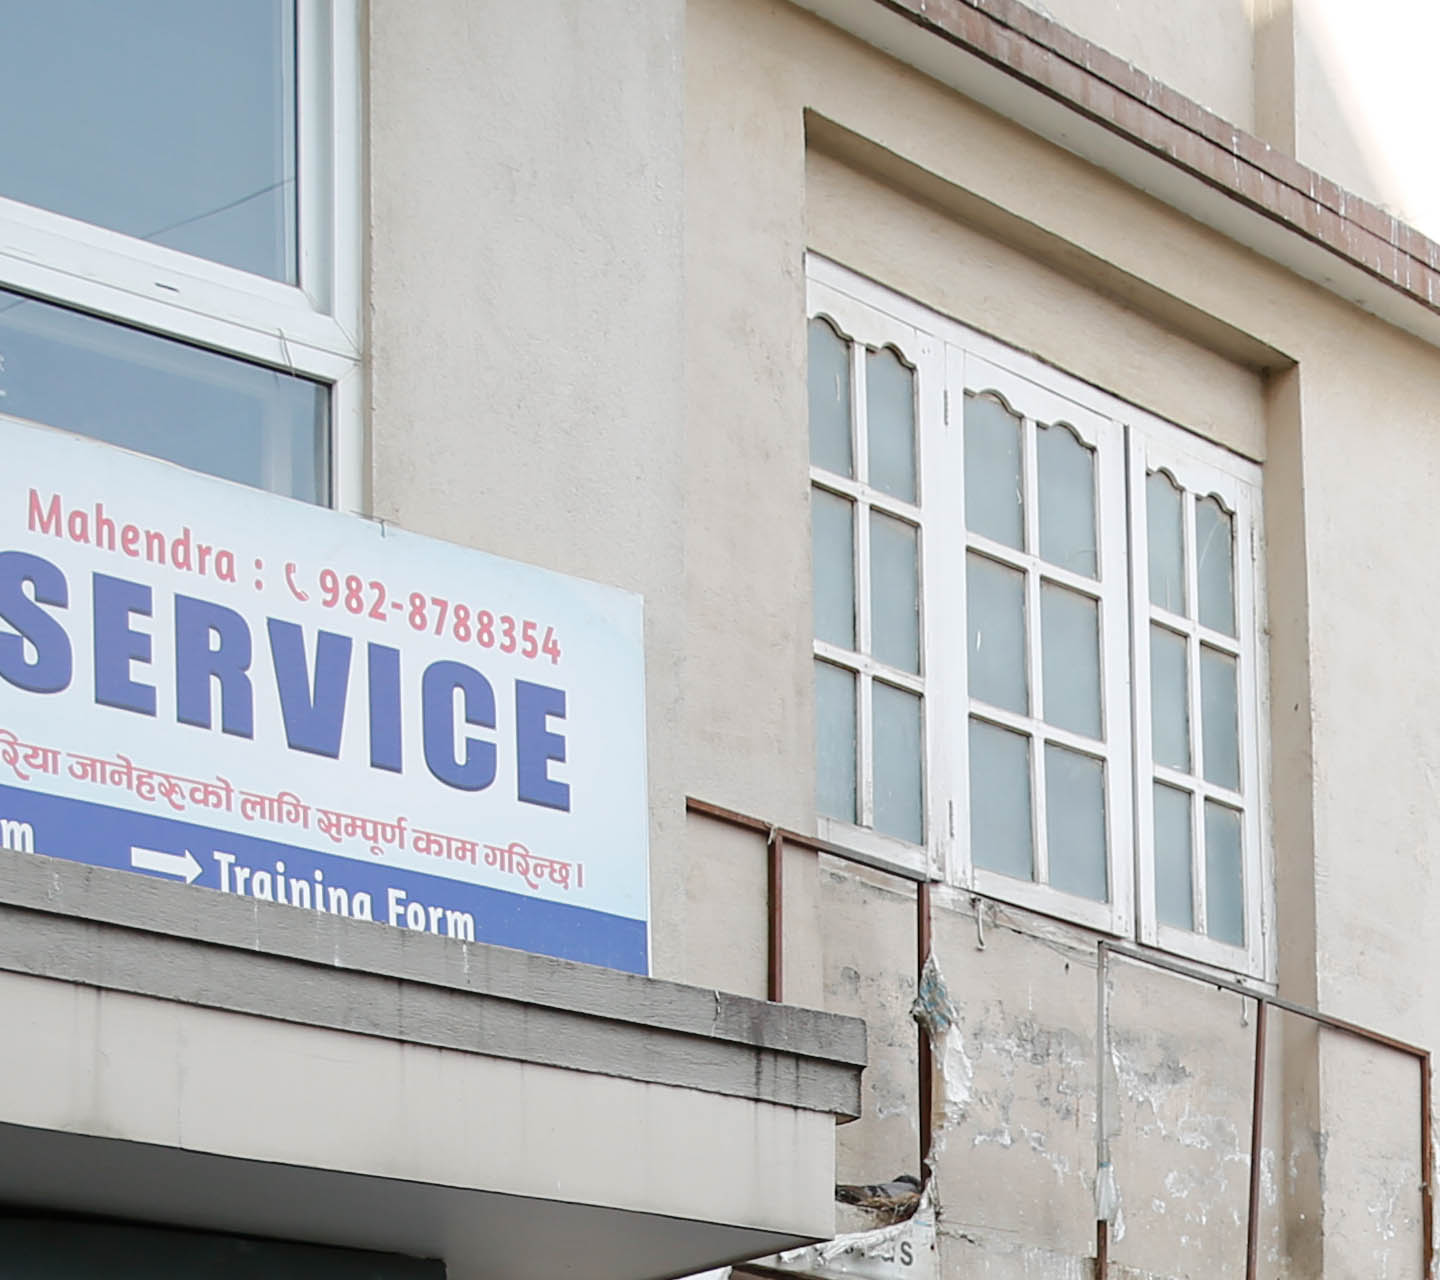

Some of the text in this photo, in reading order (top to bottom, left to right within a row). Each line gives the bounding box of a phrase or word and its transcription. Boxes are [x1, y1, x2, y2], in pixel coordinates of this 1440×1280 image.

[27, 488, 236, 583] Mahendra
[318, 568, 562, 666] 982-8788354
[240, 786, 311, 830] लागि
[317, 801, 407, 861] सम्पूर्ण
[413, 828, 478, 867] काम
[388, 888, 475, 942] Form
